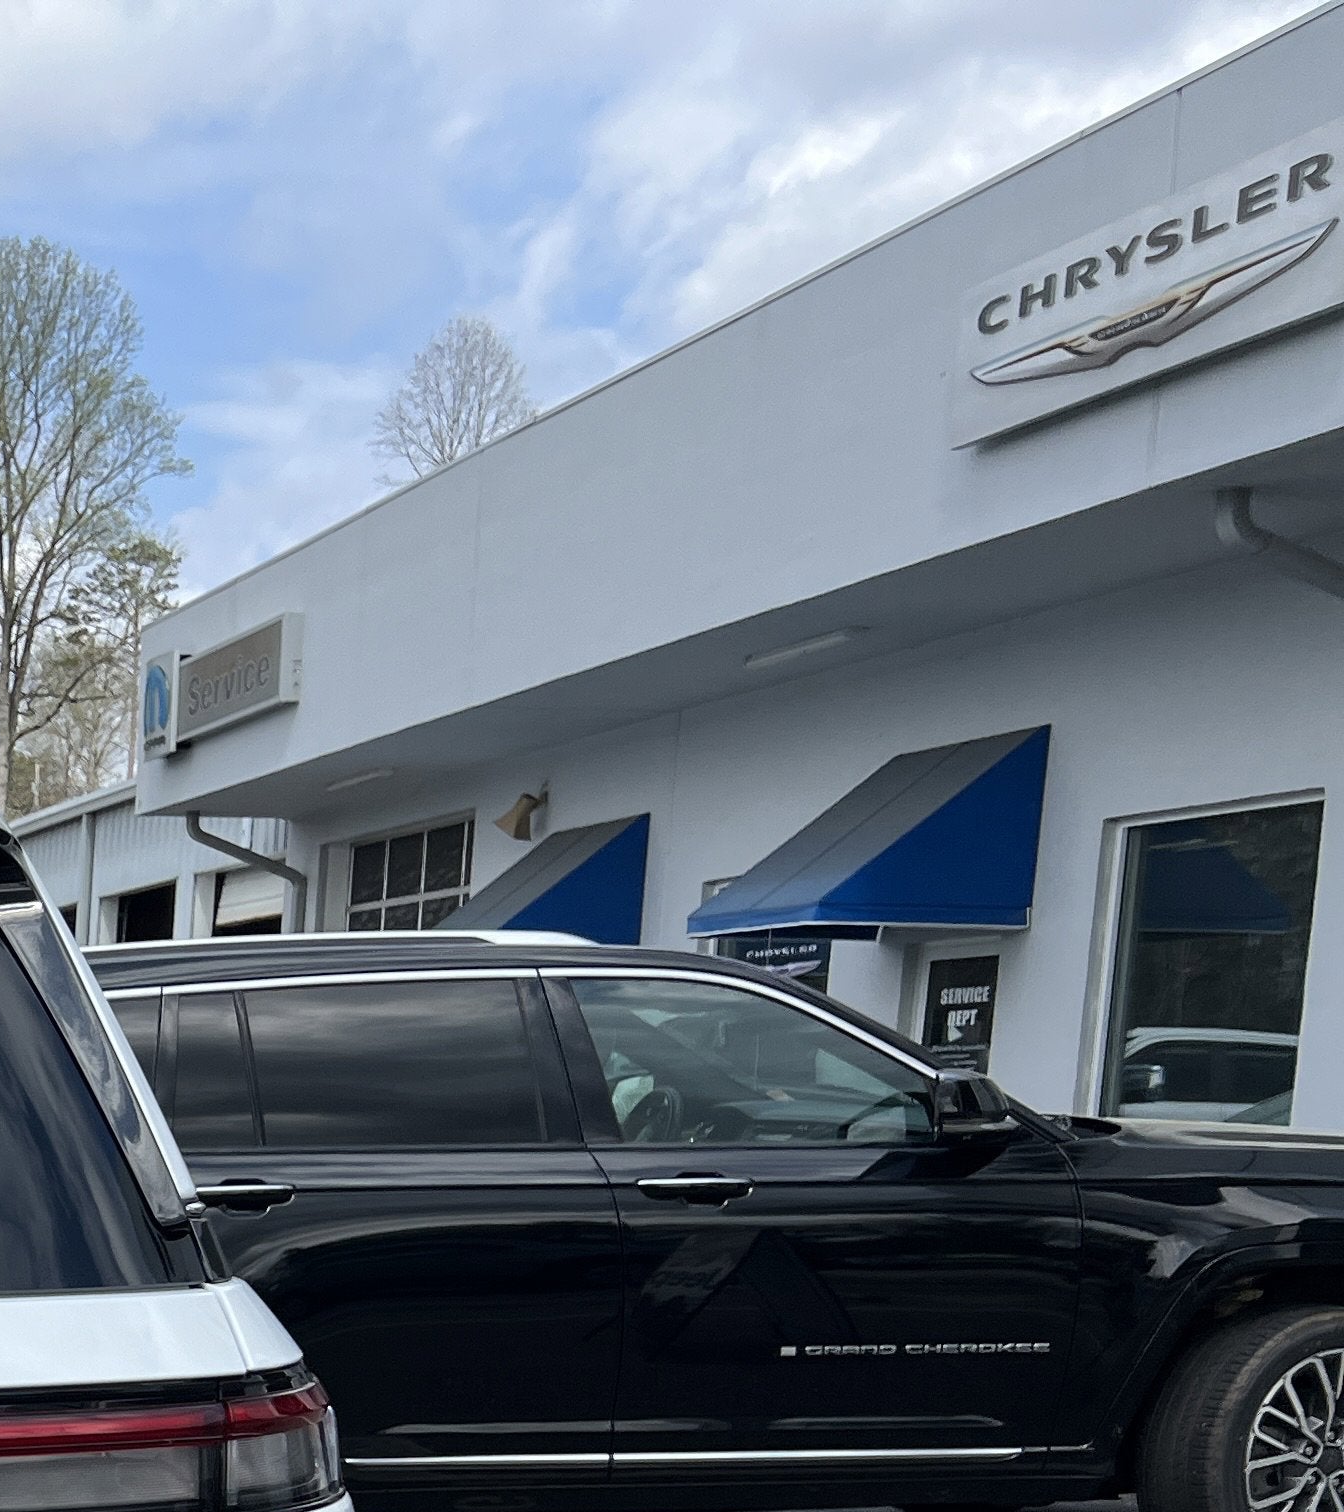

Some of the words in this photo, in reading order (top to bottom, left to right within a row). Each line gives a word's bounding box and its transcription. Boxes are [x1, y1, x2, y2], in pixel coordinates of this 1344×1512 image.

[977, 152, 1334, 335] CHRYSLER
[187, 655, 271, 716] Service
[940, 986, 991, 1005] SERVICE
[947, 1009, 978, 1027] DEPT
[805, 1345, 897, 1355] GRAND
[905, 1342, 1050, 1354] CHEROKEE
